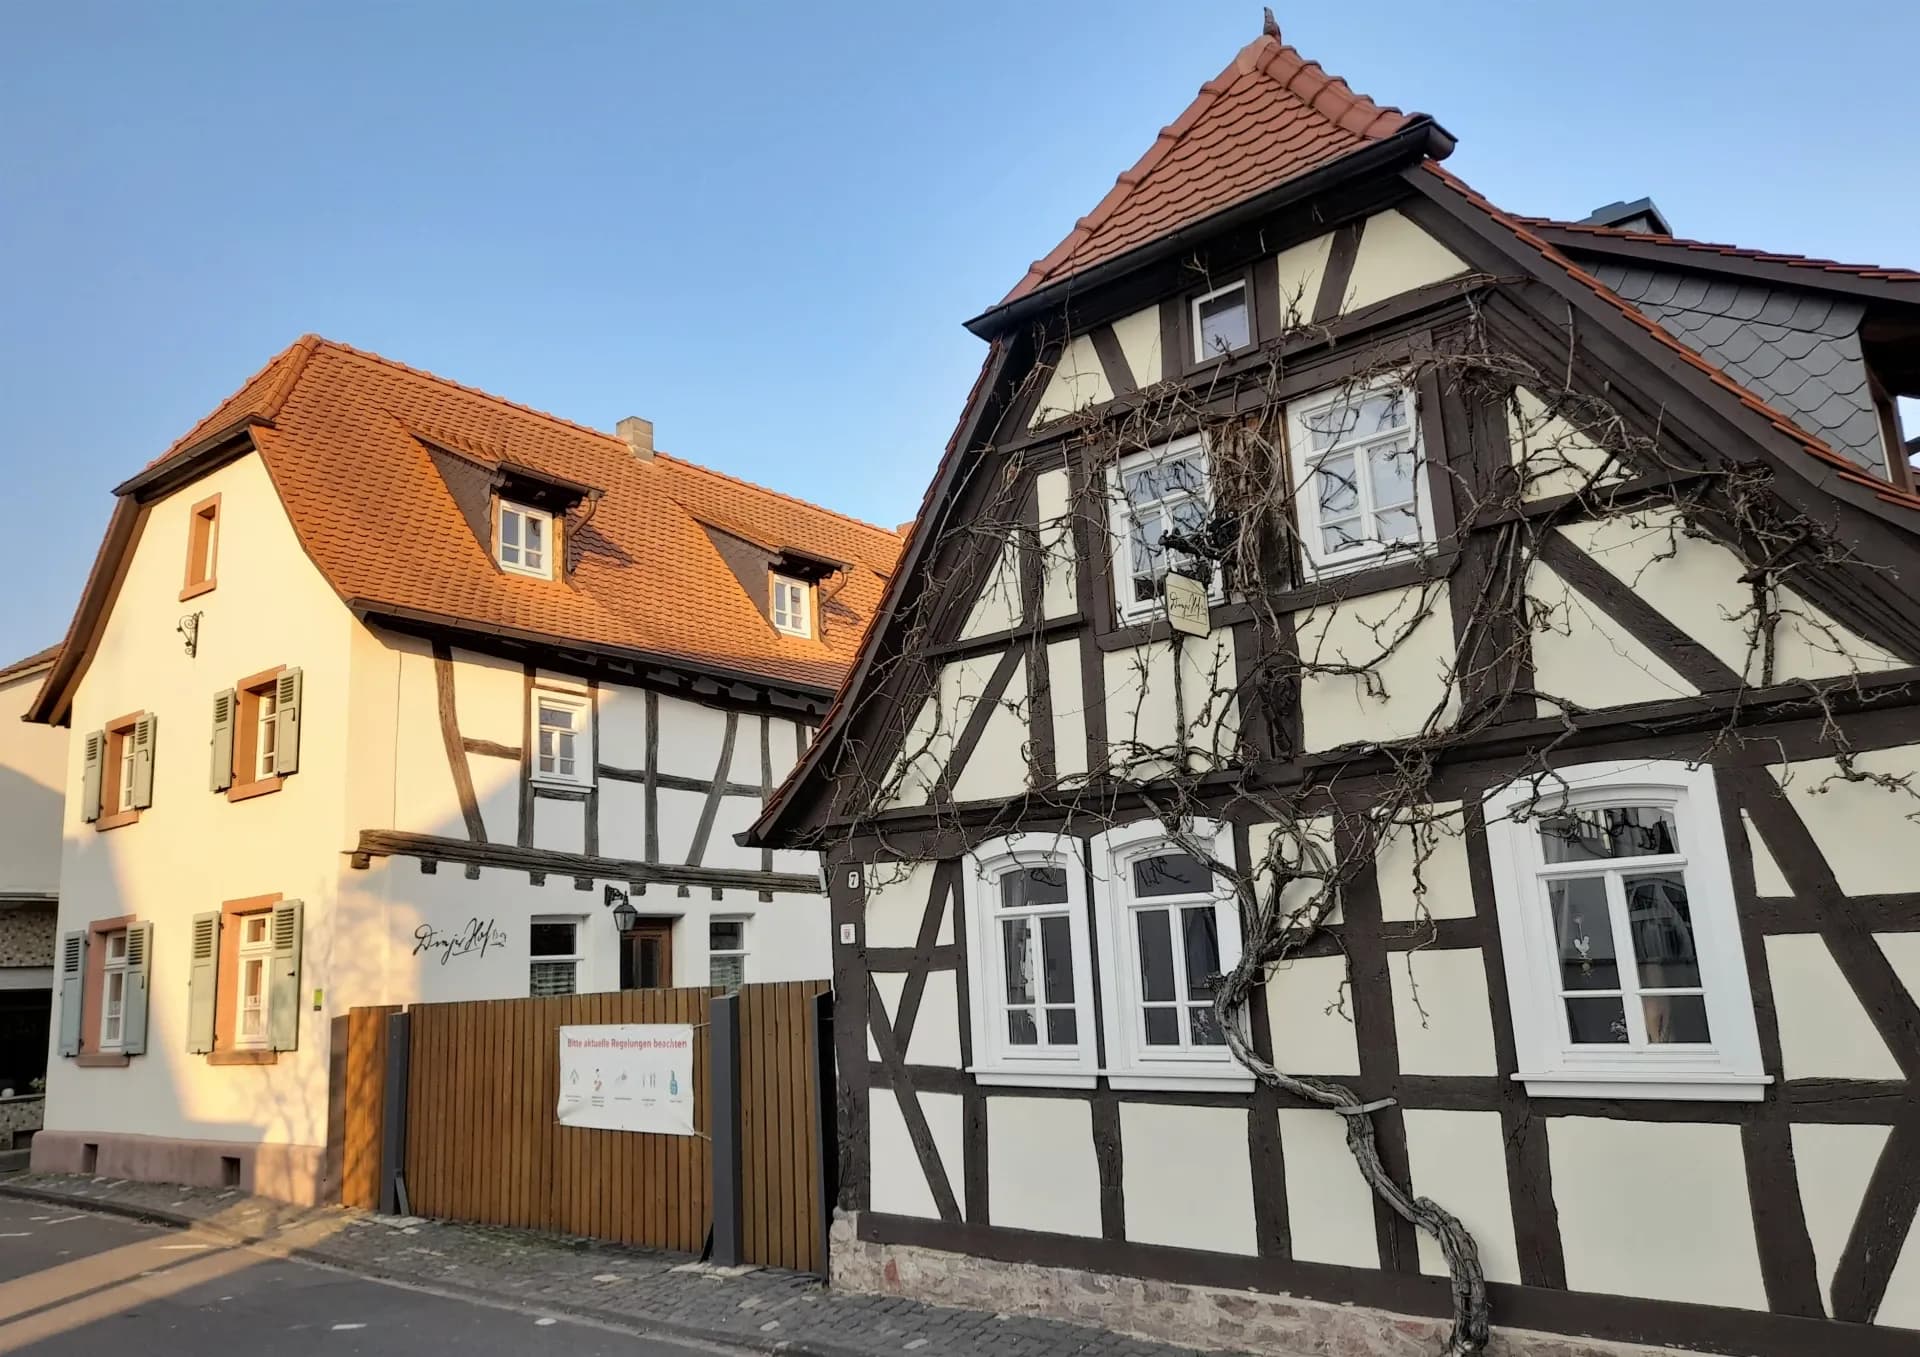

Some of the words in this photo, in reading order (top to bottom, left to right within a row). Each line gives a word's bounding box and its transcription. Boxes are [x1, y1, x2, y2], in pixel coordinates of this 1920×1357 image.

[850, 873, 857, 886] 7
[567, 1038, 582, 1049] Bitte
[583, 1038, 610, 1049] aktuelle
[610, 1038, 652, 1050] Regelungen
[653, 1038, 687, 1049] beachten
